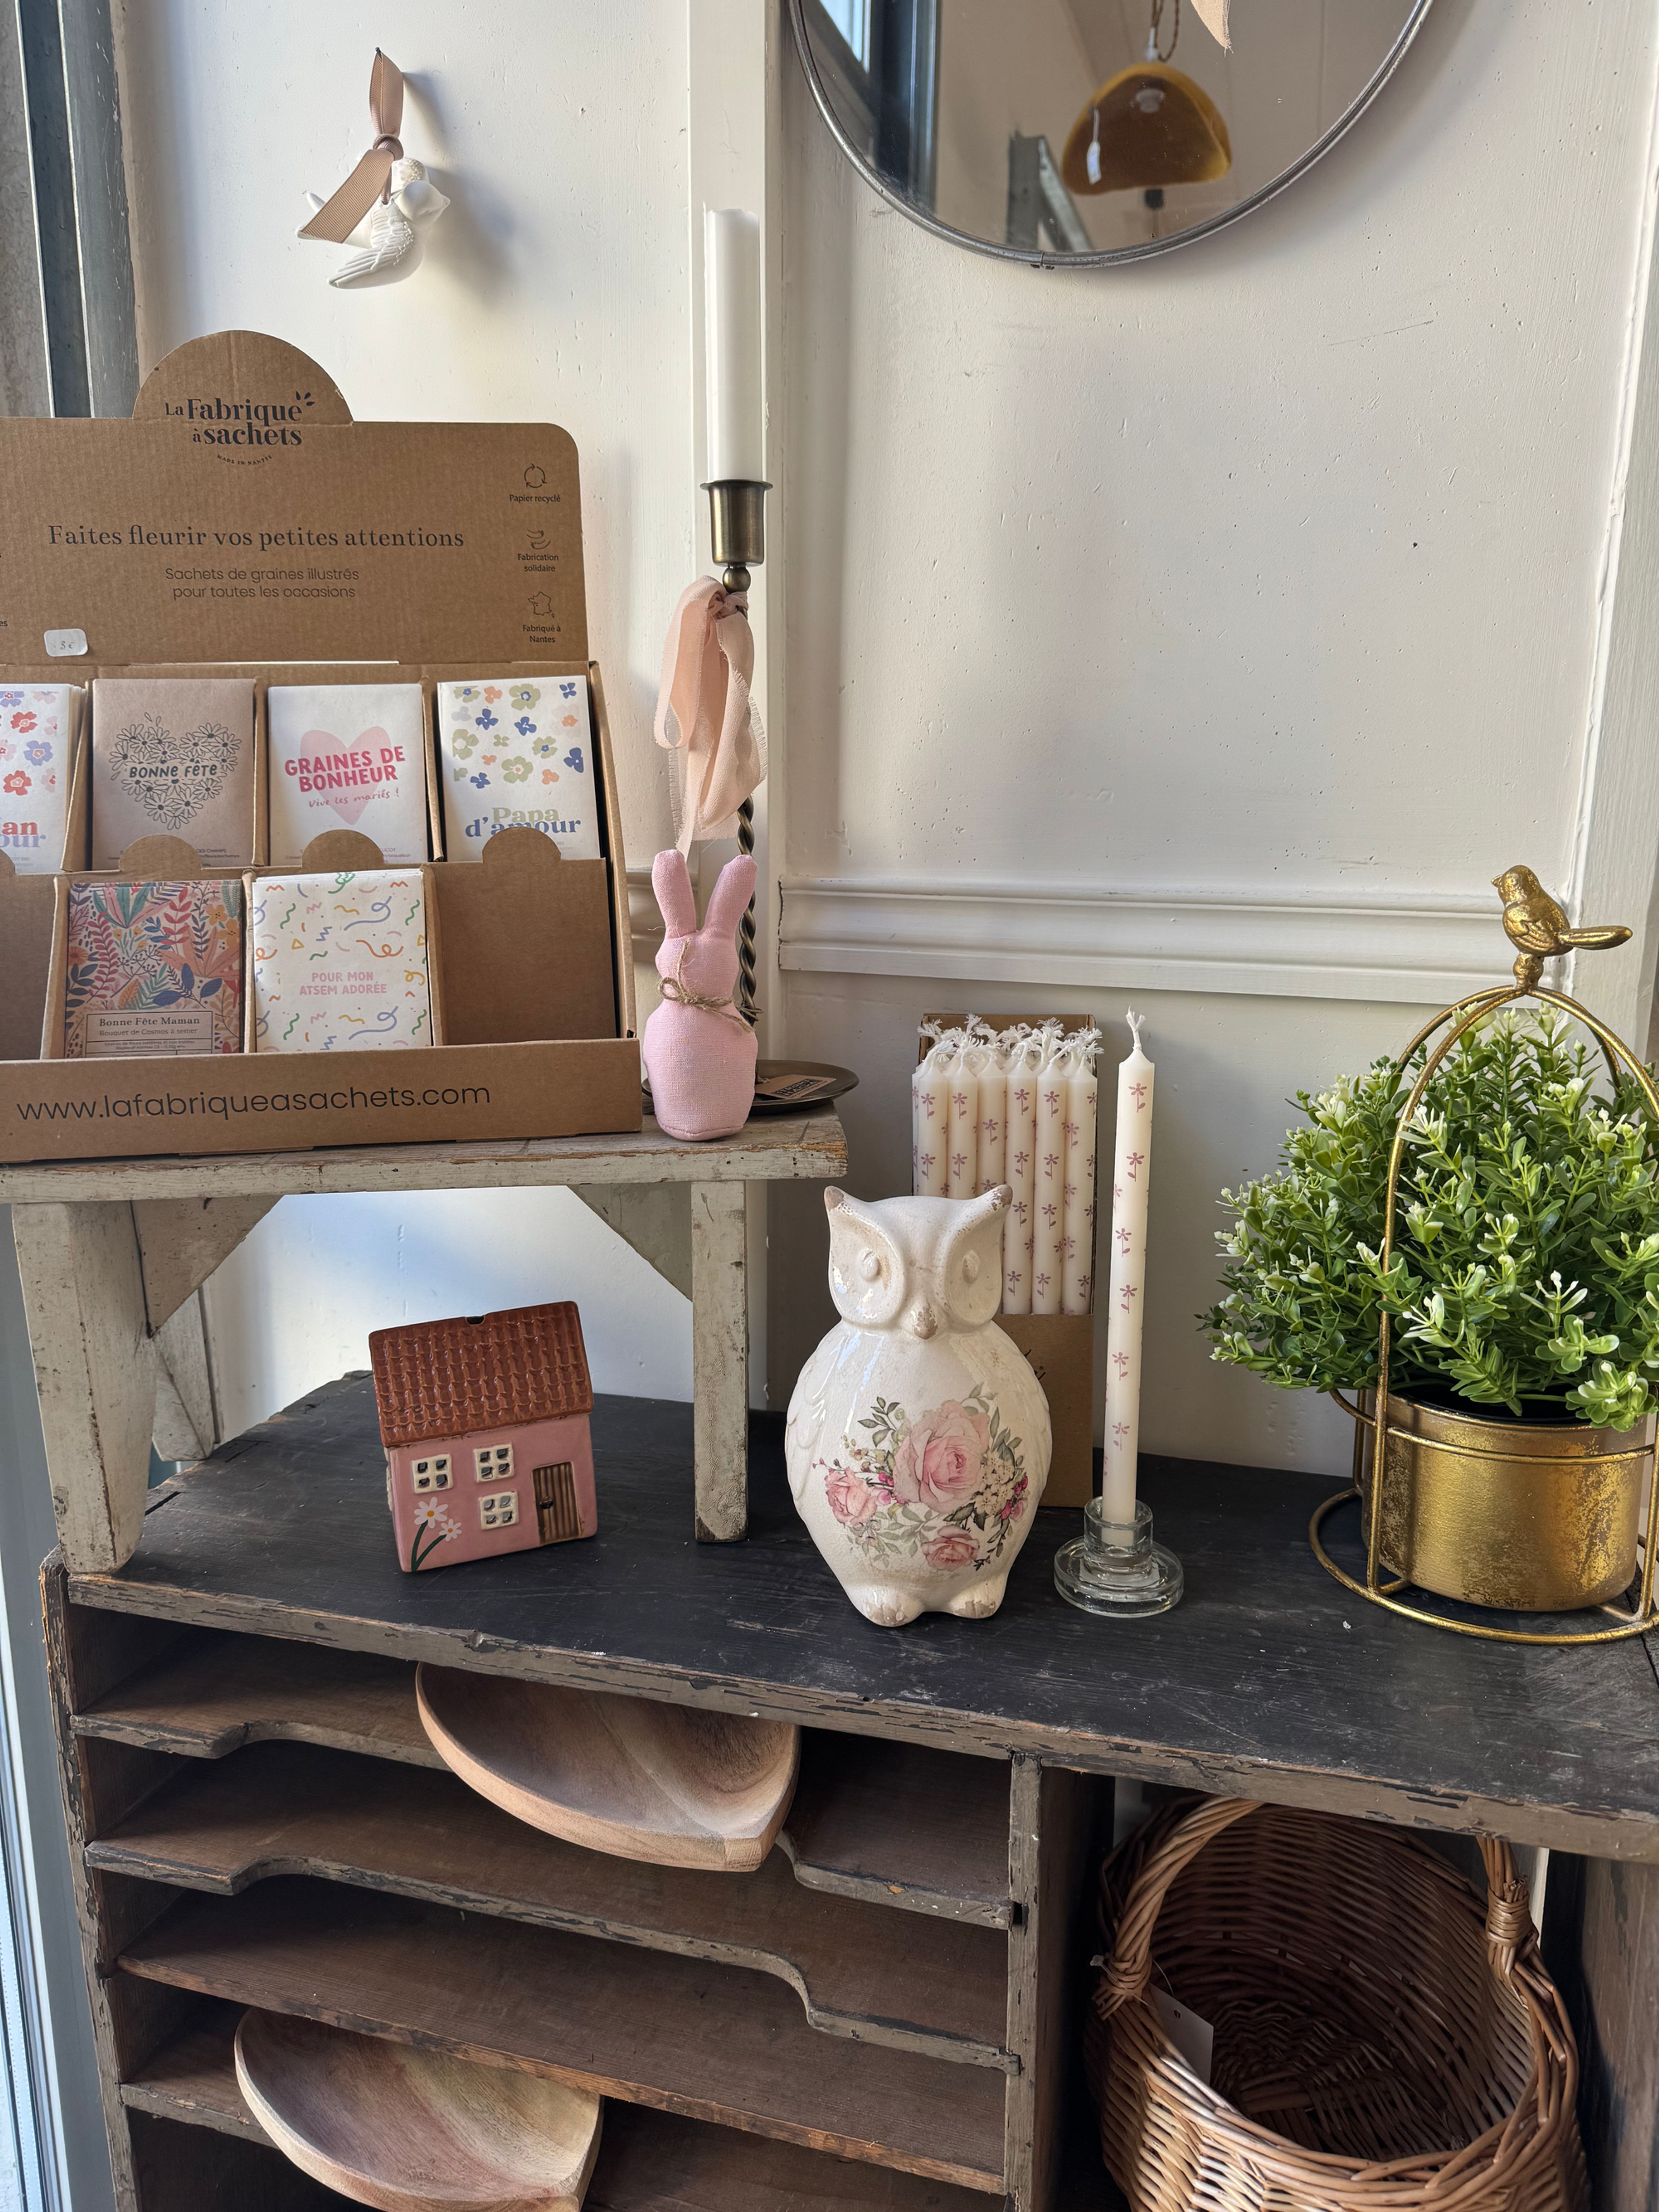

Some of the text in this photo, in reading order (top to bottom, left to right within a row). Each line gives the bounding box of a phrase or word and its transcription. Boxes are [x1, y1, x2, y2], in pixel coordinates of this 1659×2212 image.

[165, 398, 302, 426] La Fabrique
[192, 422, 302, 446] à sachets
[217, 454, 235, 464] MADE
[509, 494, 561, 503] Papier recyclé
[48, 524, 464, 551] Faites fleurir vos petites attentions
[517, 553, 559, 562] Fabrication
[165, 567, 359, 584] Sachets de graines illustrés
[524, 564, 556, 572] solidaire
[173, 586, 356, 601] pour toutes les occasions
[522, 625, 555, 634] Fabriqué
[285, 746, 406, 776] GRAINES DE
[299, 764, 398, 793] BONHEUR
[335, 796, 349, 805] les
[354, 789, 390, 803] mariés
[492, 807, 560, 826] Papa
[312, 971, 374, 982] POUR MON
[299, 985, 338, 995] ATSEM
[99, 1017, 200, 1027] Bonne Fête Maman
[17, 1086, 490, 1120] www.lafabriqueasachets.com
